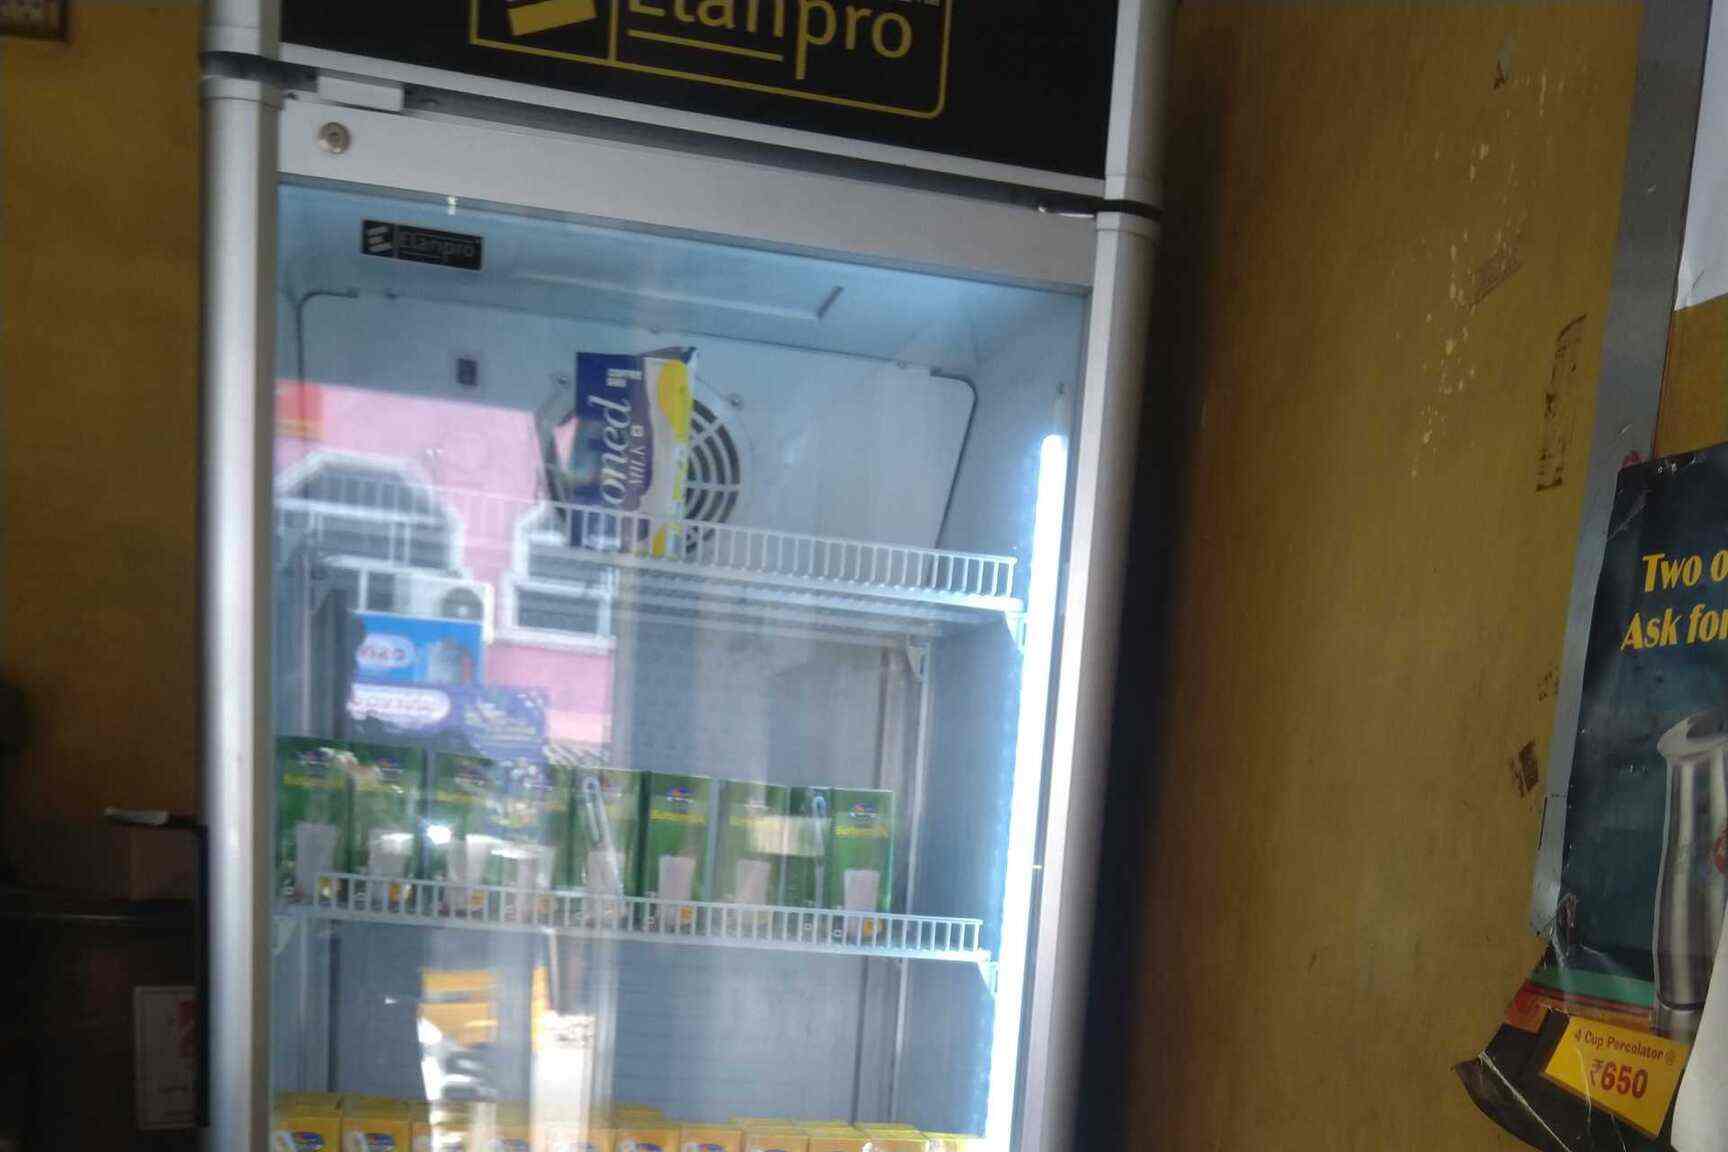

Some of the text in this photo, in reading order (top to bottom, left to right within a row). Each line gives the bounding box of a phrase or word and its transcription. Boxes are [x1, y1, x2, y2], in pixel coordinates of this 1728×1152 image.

[628, 0, 913, 80] anpro
[1641, 552, 1703, 593] Two
[1620, 608, 1681, 652] Ask
